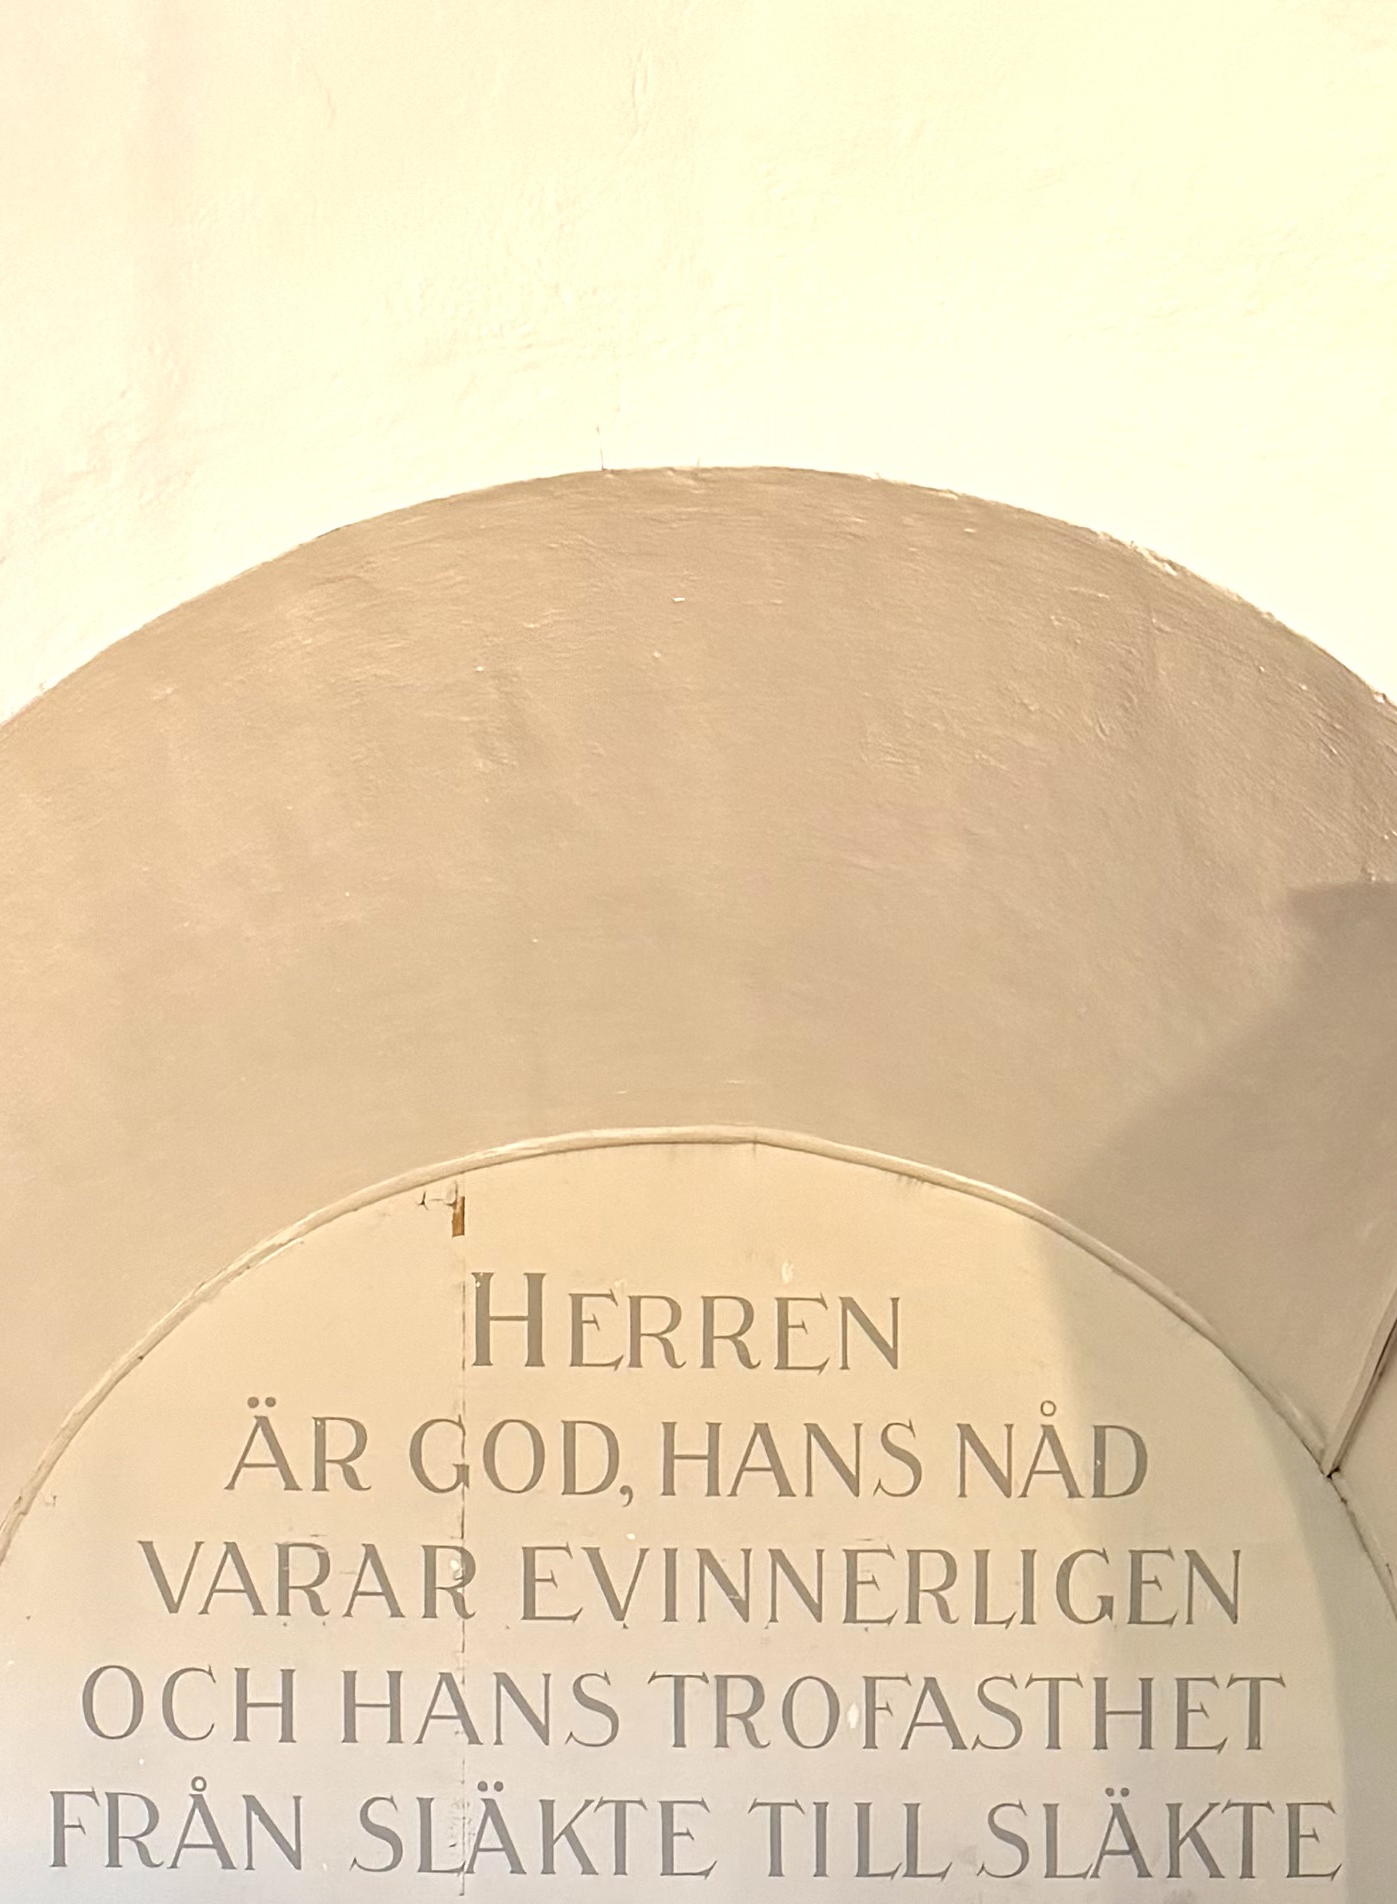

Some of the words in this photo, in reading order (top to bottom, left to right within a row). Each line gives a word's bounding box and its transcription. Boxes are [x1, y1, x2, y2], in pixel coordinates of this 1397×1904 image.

[471, 1272, 901, 1375] HERREN
[224, 1397, 371, 1492] ÄR
[409, 1414, 634, 1507] GOD,
[661, 1419, 923, 1498] HANS
[956, 1400, 1148, 1499] NÅD
[137, 1540, 477, 1620] VARAR
[521, 1542, 1242, 1629] EVINNERLIGEN
[82, 1665, 298, 1743] OCH
[341, 1670, 620, 1747] HANS
[648, 1671, 1286, 1754] TROFASTHET
[50, 1776, 303, 1871] FRÅN
[350, 1781, 718, 1879] SLÄKTE
[748, 1798, 953, 1881] TILL
[976, 1788, 1342, 1881] SLÄKTE
